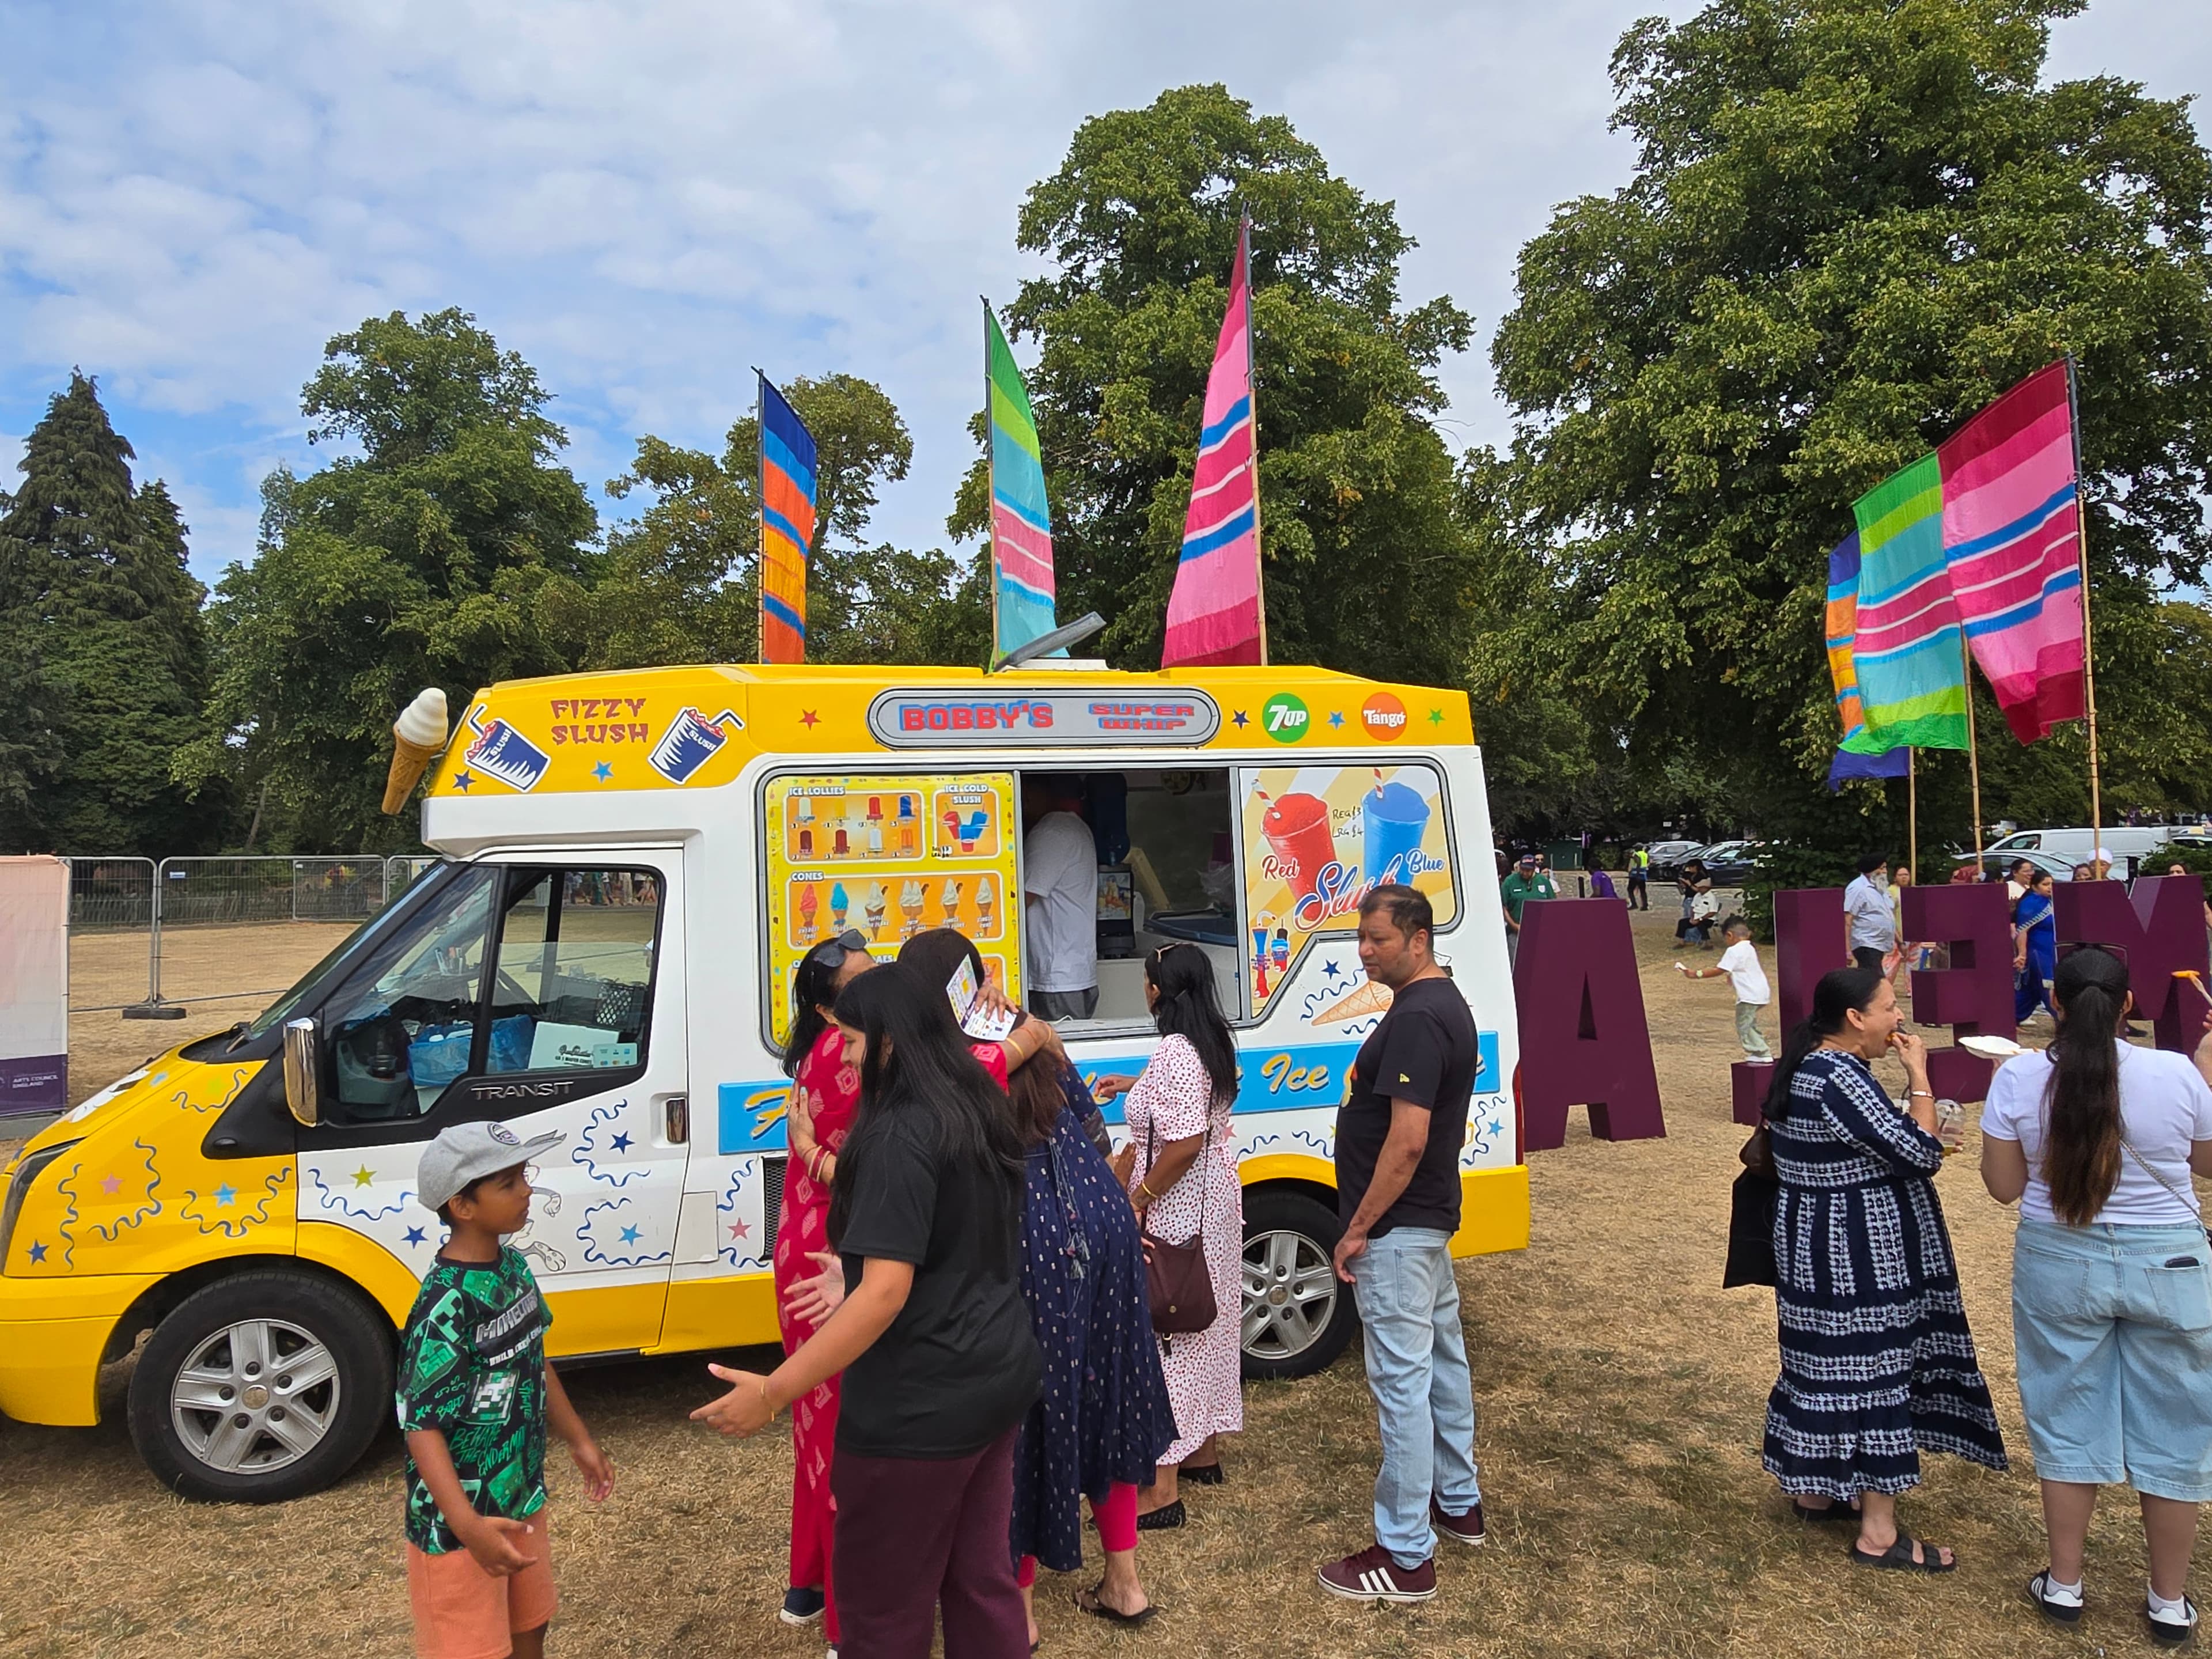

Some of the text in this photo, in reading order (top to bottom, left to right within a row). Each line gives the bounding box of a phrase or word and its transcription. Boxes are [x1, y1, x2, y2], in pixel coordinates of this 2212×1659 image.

[551, 698, 646, 719] FIZZY
[899, 700, 1054, 731] BOBBY'S
[1089, 704, 1194, 716] SUPER
[1268, 704, 1306, 732] 7UP
[1363, 709, 1406, 728] Tango
[551, 724, 649, 745] SLUSH
[1099, 718, 1187, 730] WHIP
[490, 728, 512, 756] SLUSH
[688, 729, 717, 751] SLUSH
[789, 786, 844, 796] ICE LOLLIES
[945, 784, 988, 793] ICE COLD
[953, 796, 982, 804] SLUSH
[1262, 854, 1300, 880] Red
[1406, 848, 1446, 874] Blue
[791, 872, 824, 881] CONES
[1261, 1053, 1330, 1094] Ice
[471, 1082, 574, 1100] TRANSIT
